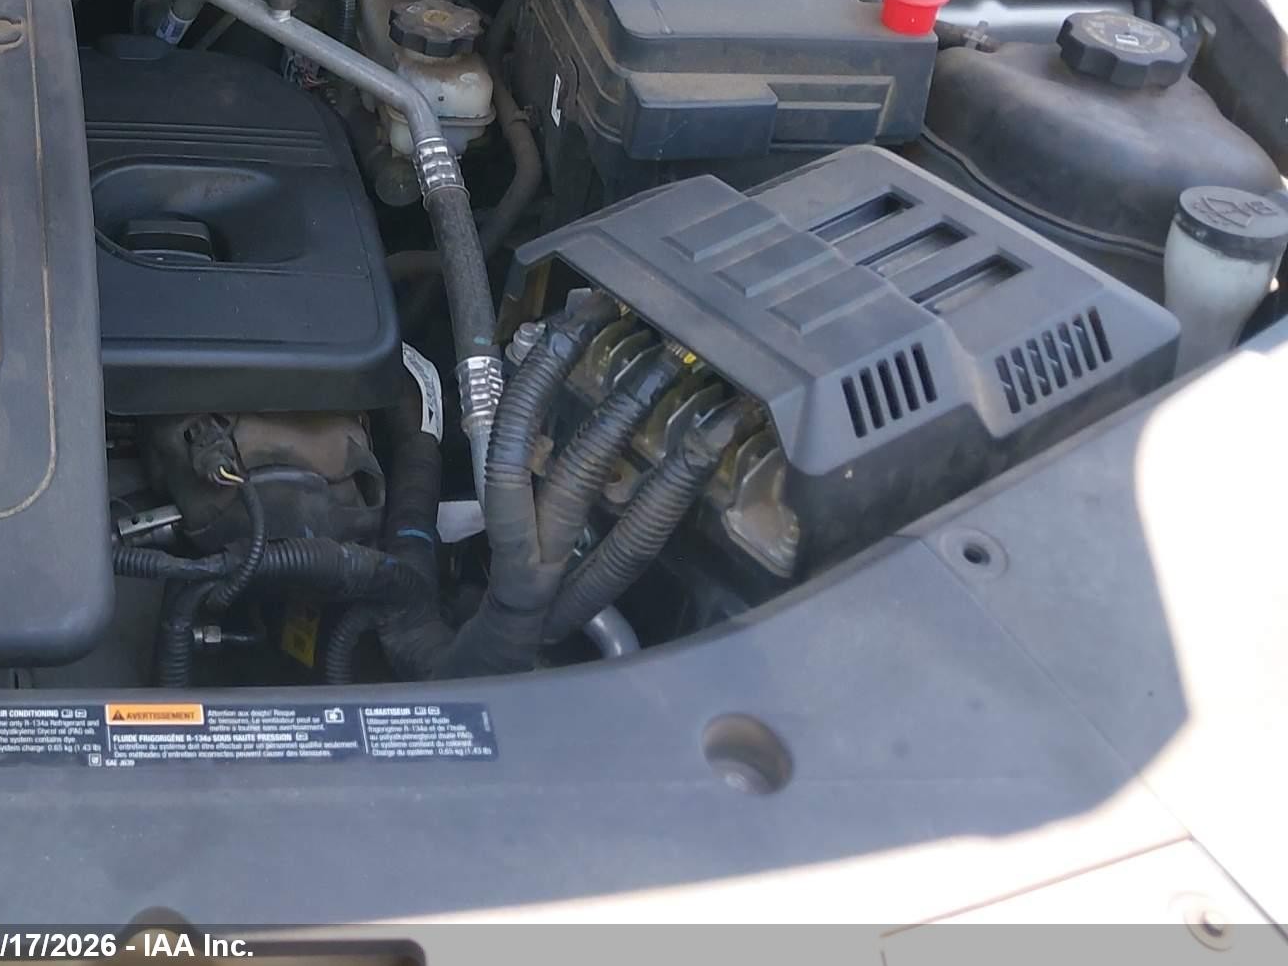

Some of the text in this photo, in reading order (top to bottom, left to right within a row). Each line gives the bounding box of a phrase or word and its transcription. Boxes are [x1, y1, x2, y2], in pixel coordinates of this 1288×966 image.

[9, 710, 59, 718] CONDITIONING
[126, 712, 194, 720] AVERTISSEMENT
[9, 719, 22, 727] only
[87, 719, 100, 727] and
[10, 736, 33, 744] system
[35, 736, 62, 744] contains
[113, 735, 137, 743] FLUIDE
[213, 734, 232, 742] SOUS
[233, 734, 256, 742] HAUTE
[257, 734, 292, 742] PRESSION
